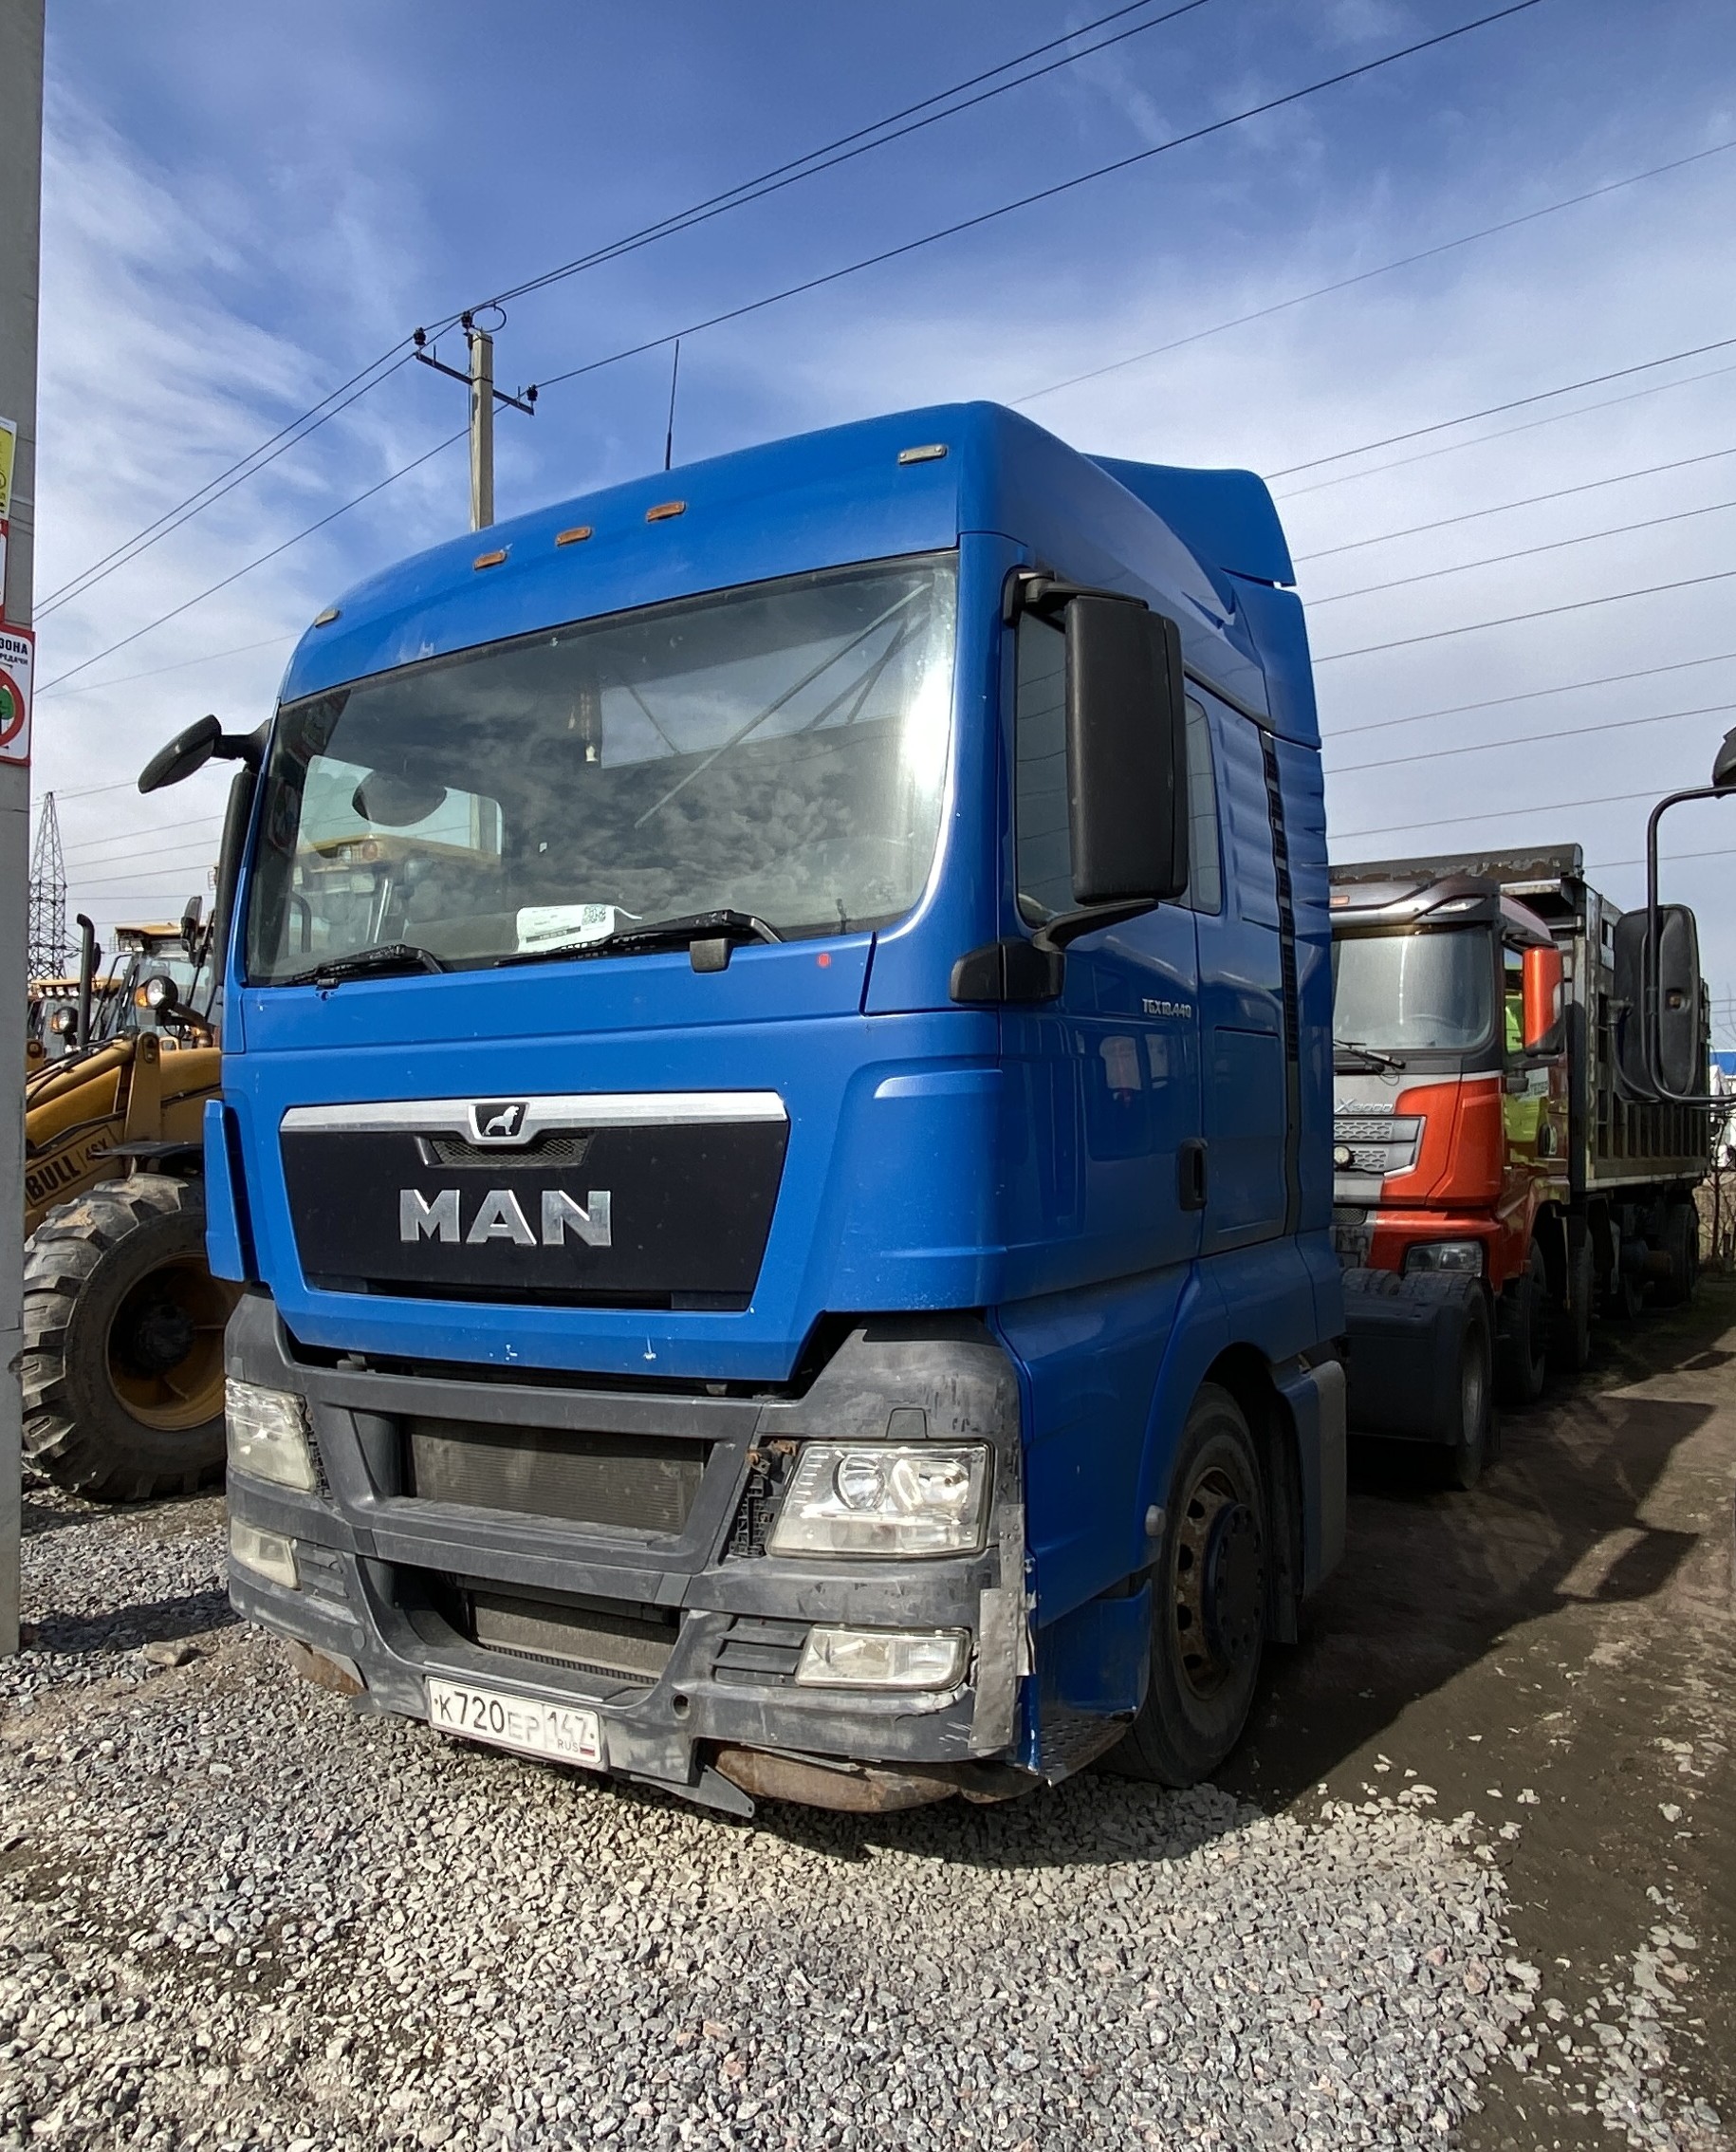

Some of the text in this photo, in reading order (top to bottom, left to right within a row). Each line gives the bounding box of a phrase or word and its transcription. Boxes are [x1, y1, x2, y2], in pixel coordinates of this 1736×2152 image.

[27, 1155, 81, 1200] BULL
[399, 1189, 612, 1247] MAN
[557, 1738, 579, 1752] RUS
